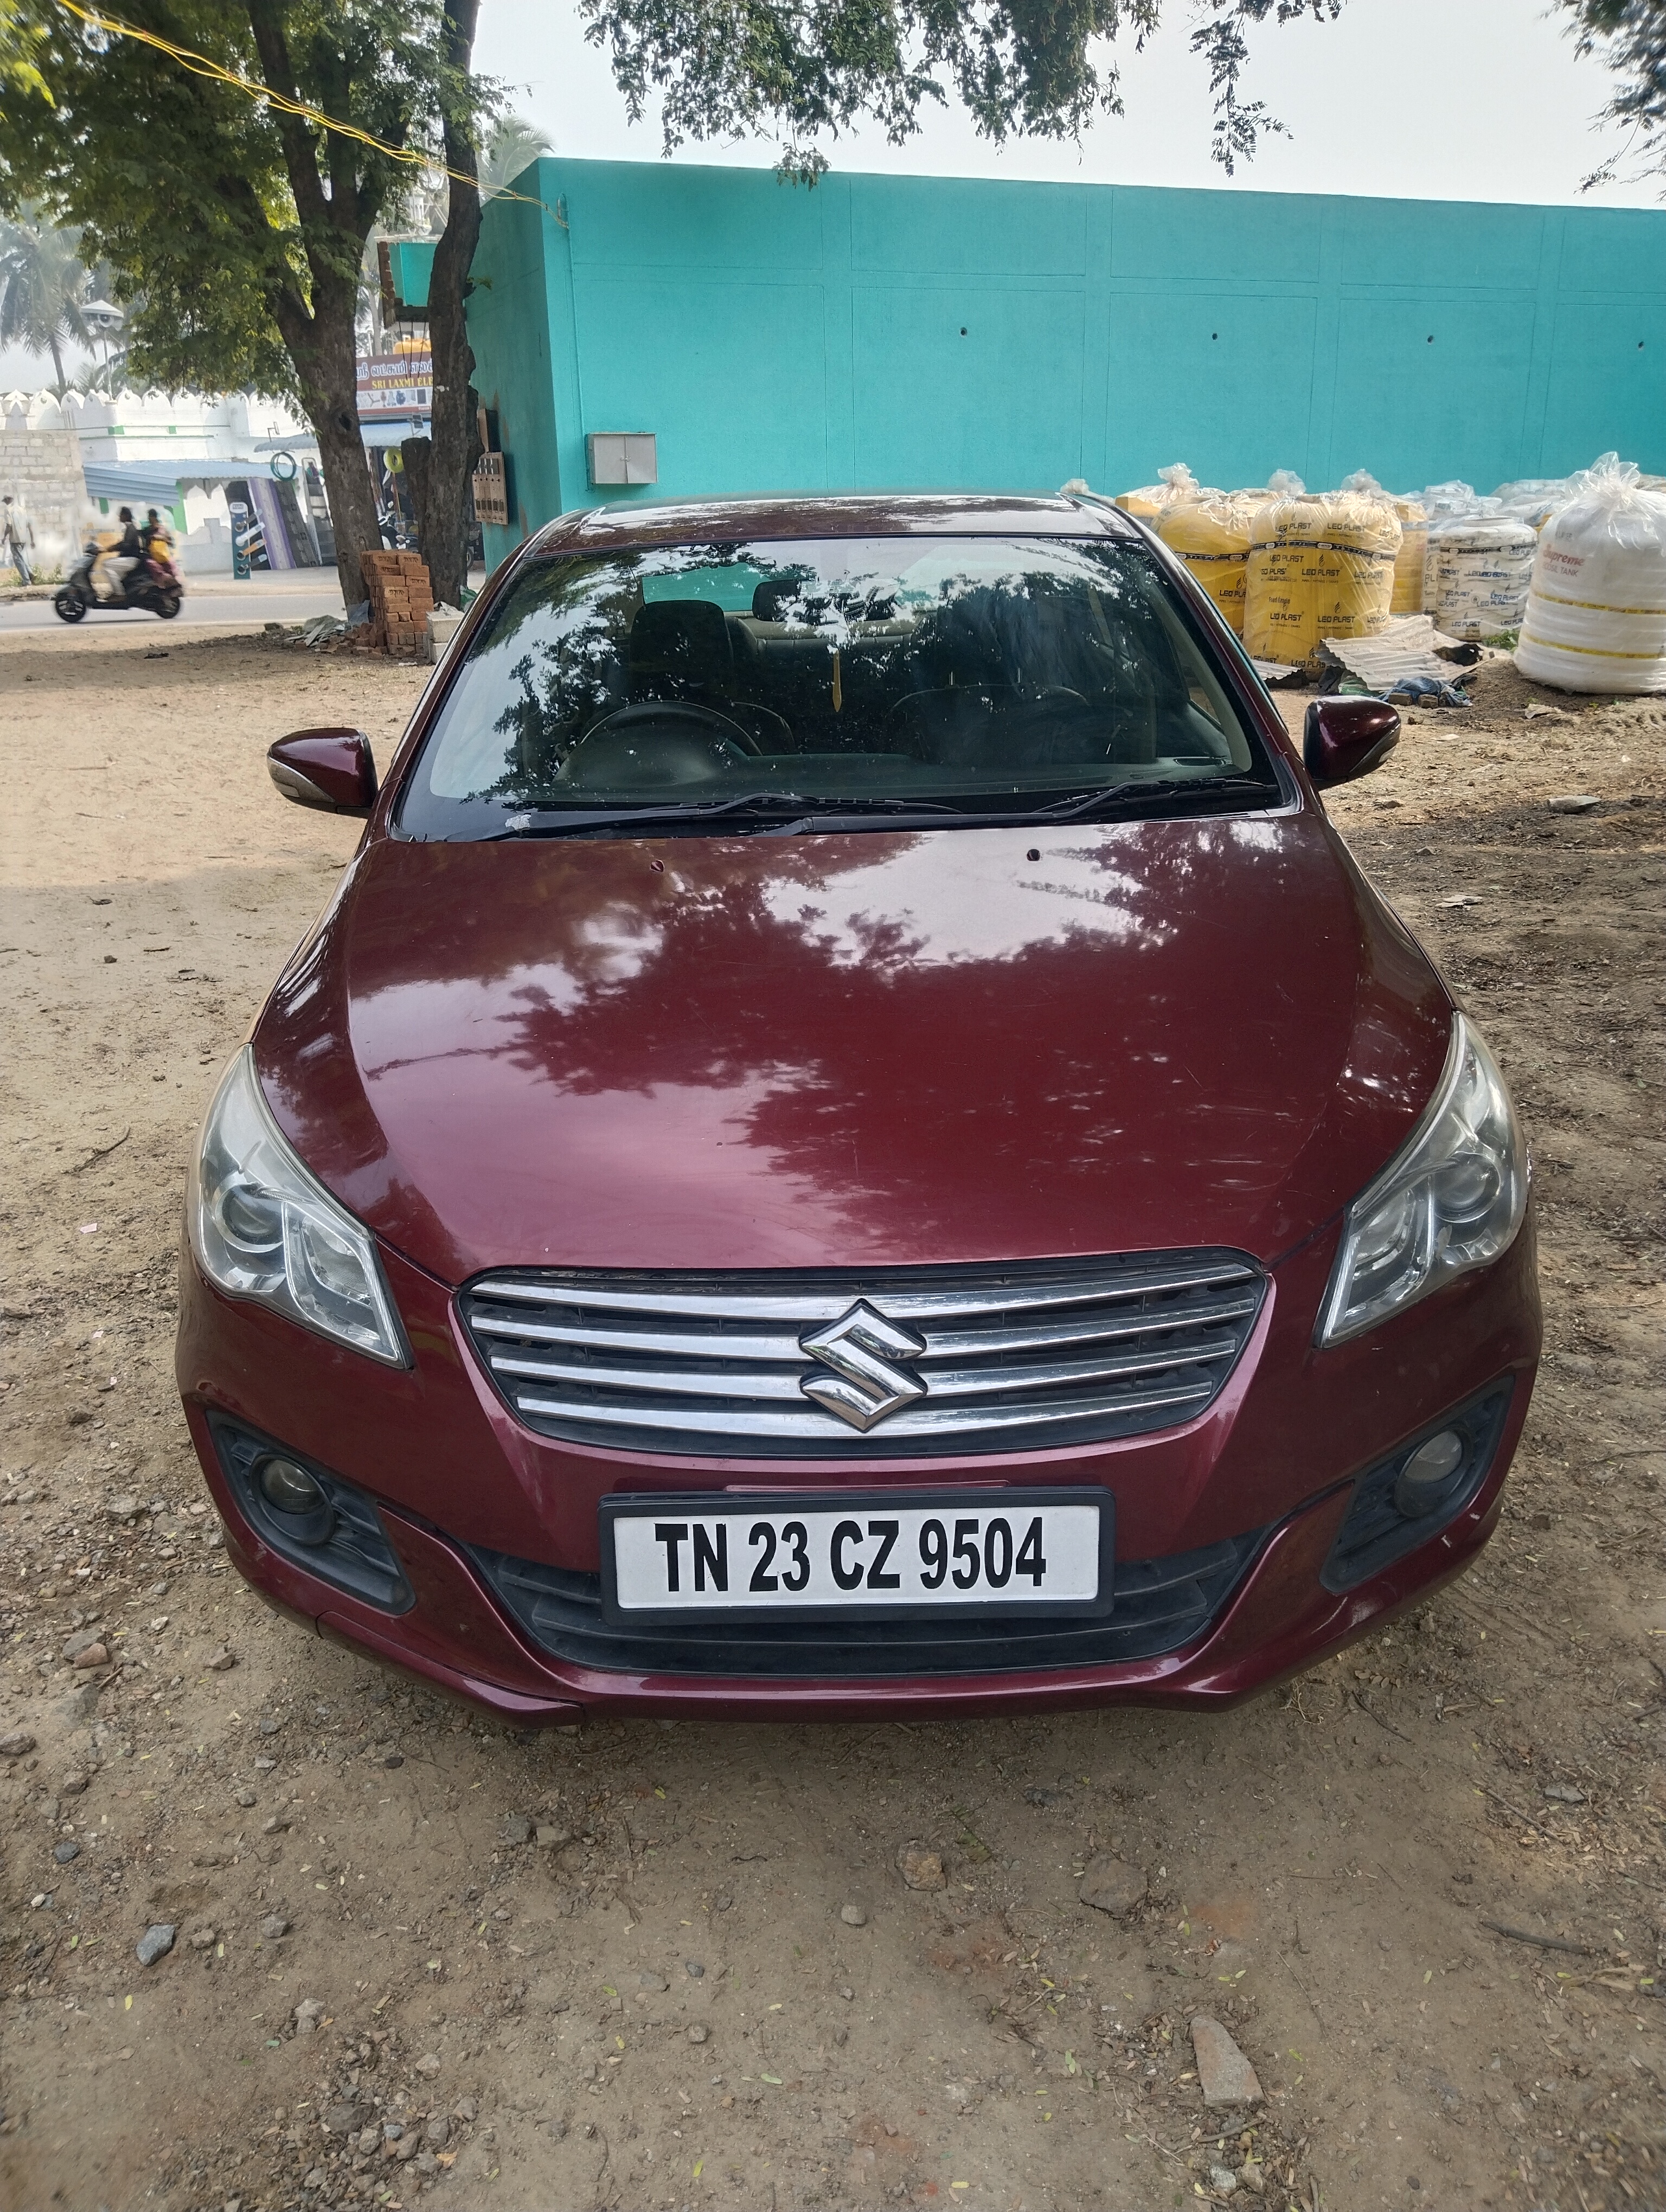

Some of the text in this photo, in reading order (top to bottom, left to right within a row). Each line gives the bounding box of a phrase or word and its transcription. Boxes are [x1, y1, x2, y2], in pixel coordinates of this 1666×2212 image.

[372, 380, 386, 389] SRI
[388, 378, 414, 389] LAXMI
[1282, 555, 1304, 563] PLAST
[1543, 544, 1585, 567] Supreme
[1318, 569, 1340, 577] PLAST
[1560, 567, 1579, 577] TANK
[655, 1516, 1047, 1592] TN 23 CZ 9504
